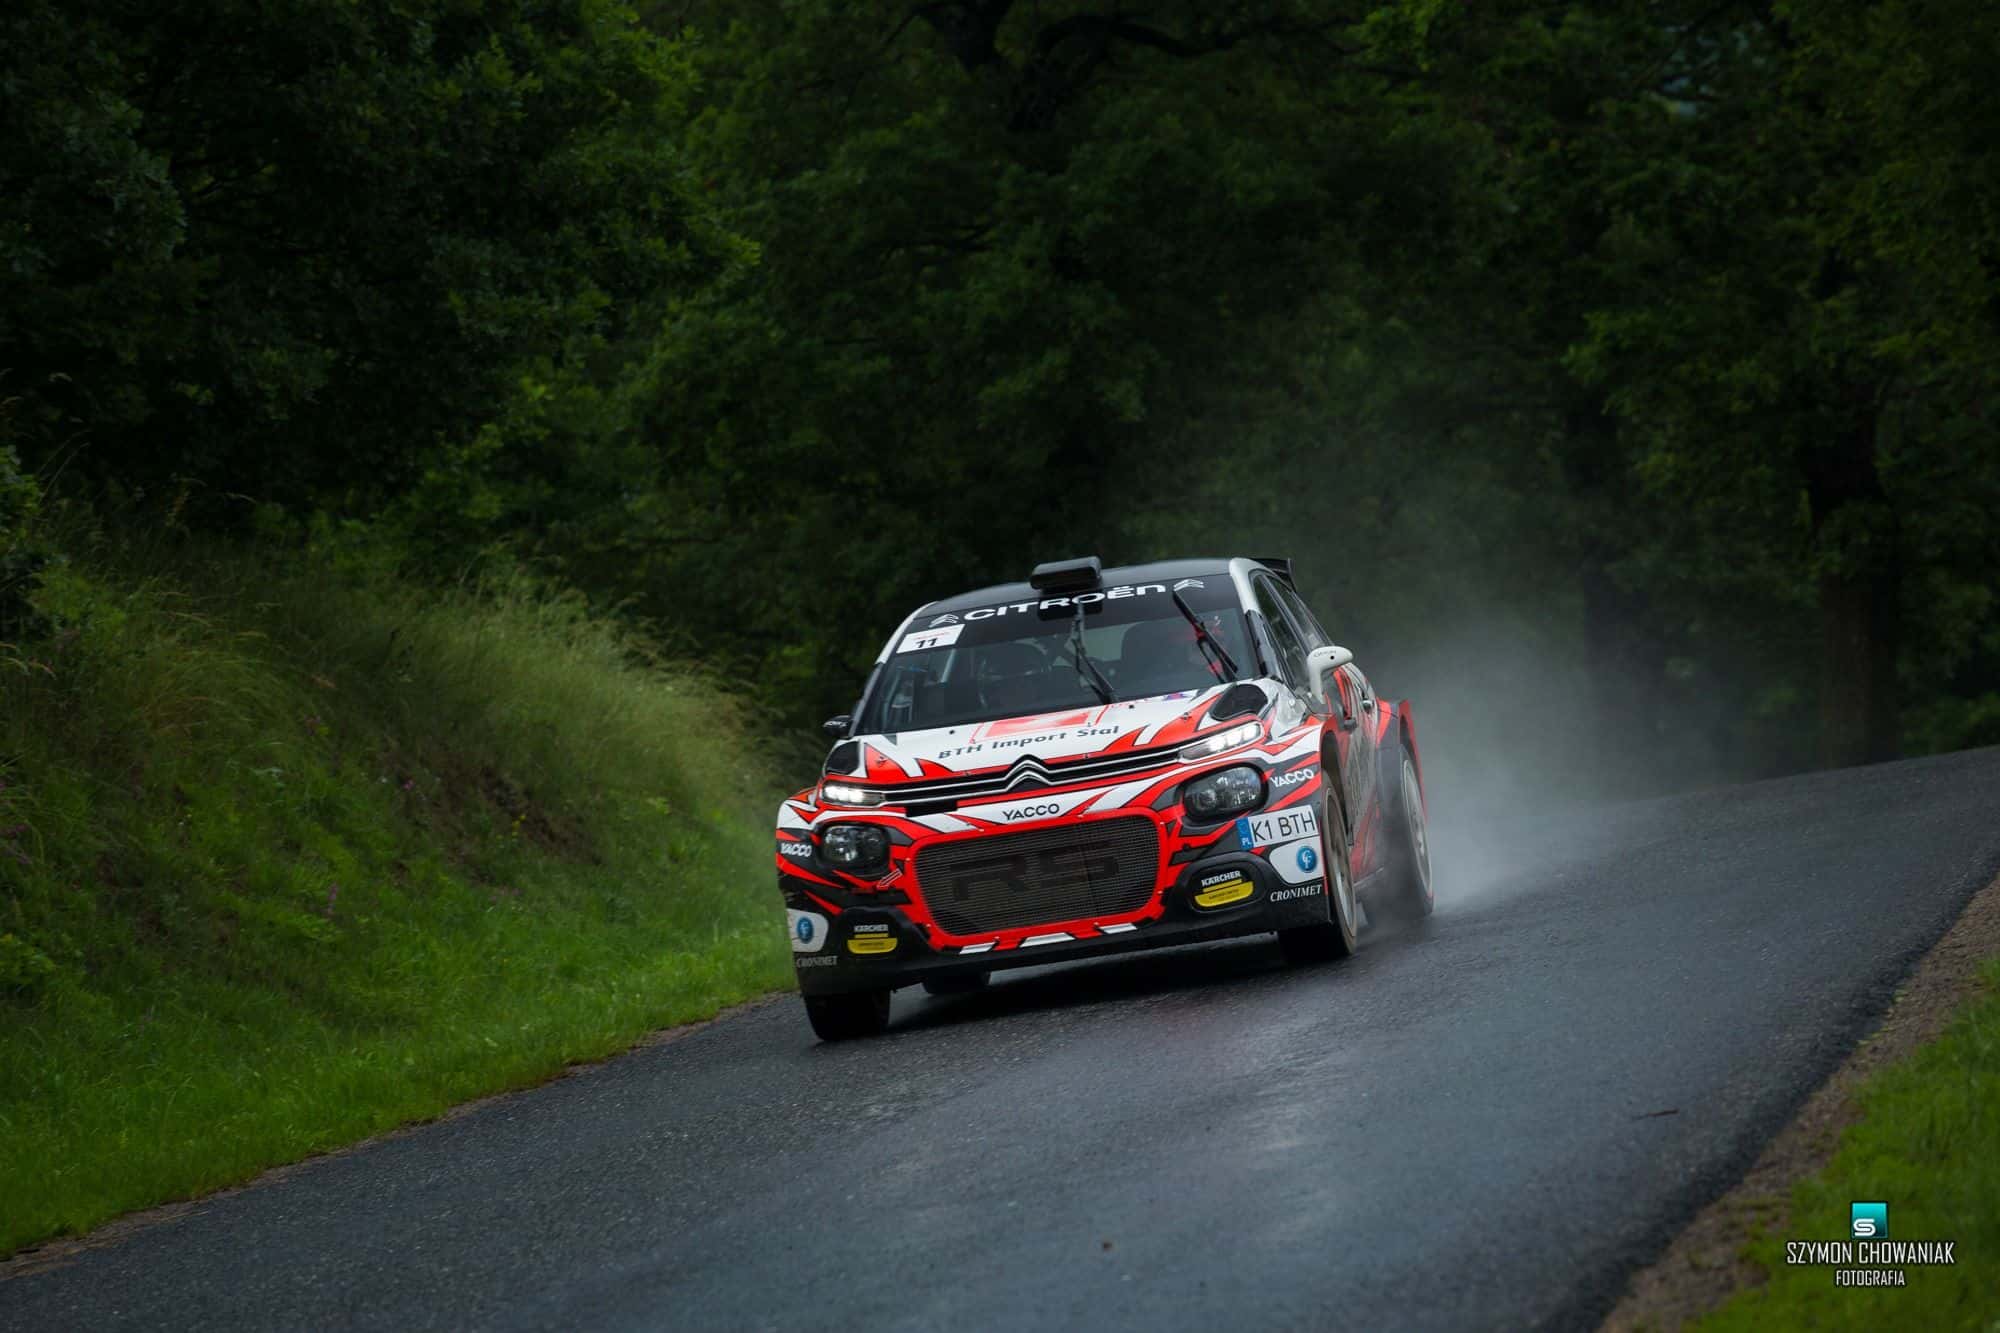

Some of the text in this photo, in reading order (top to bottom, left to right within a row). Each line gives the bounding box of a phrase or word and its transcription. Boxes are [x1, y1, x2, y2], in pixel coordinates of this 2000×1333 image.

[915, 637, 938, 650] 11
[938, 725, 1120, 760] BTH Import Stal
[1270, 768, 1315, 788] YACCO
[1002, 803, 1060, 820] YACCO
[1251, 812, 1316, 841] K1 BTH
[1241, 837, 1252, 846] PL
[780, 843, 813, 858] YACCO
[1270, 884, 1322, 903] CRONIMET
[796, 956, 837, 969] CRONIMET
